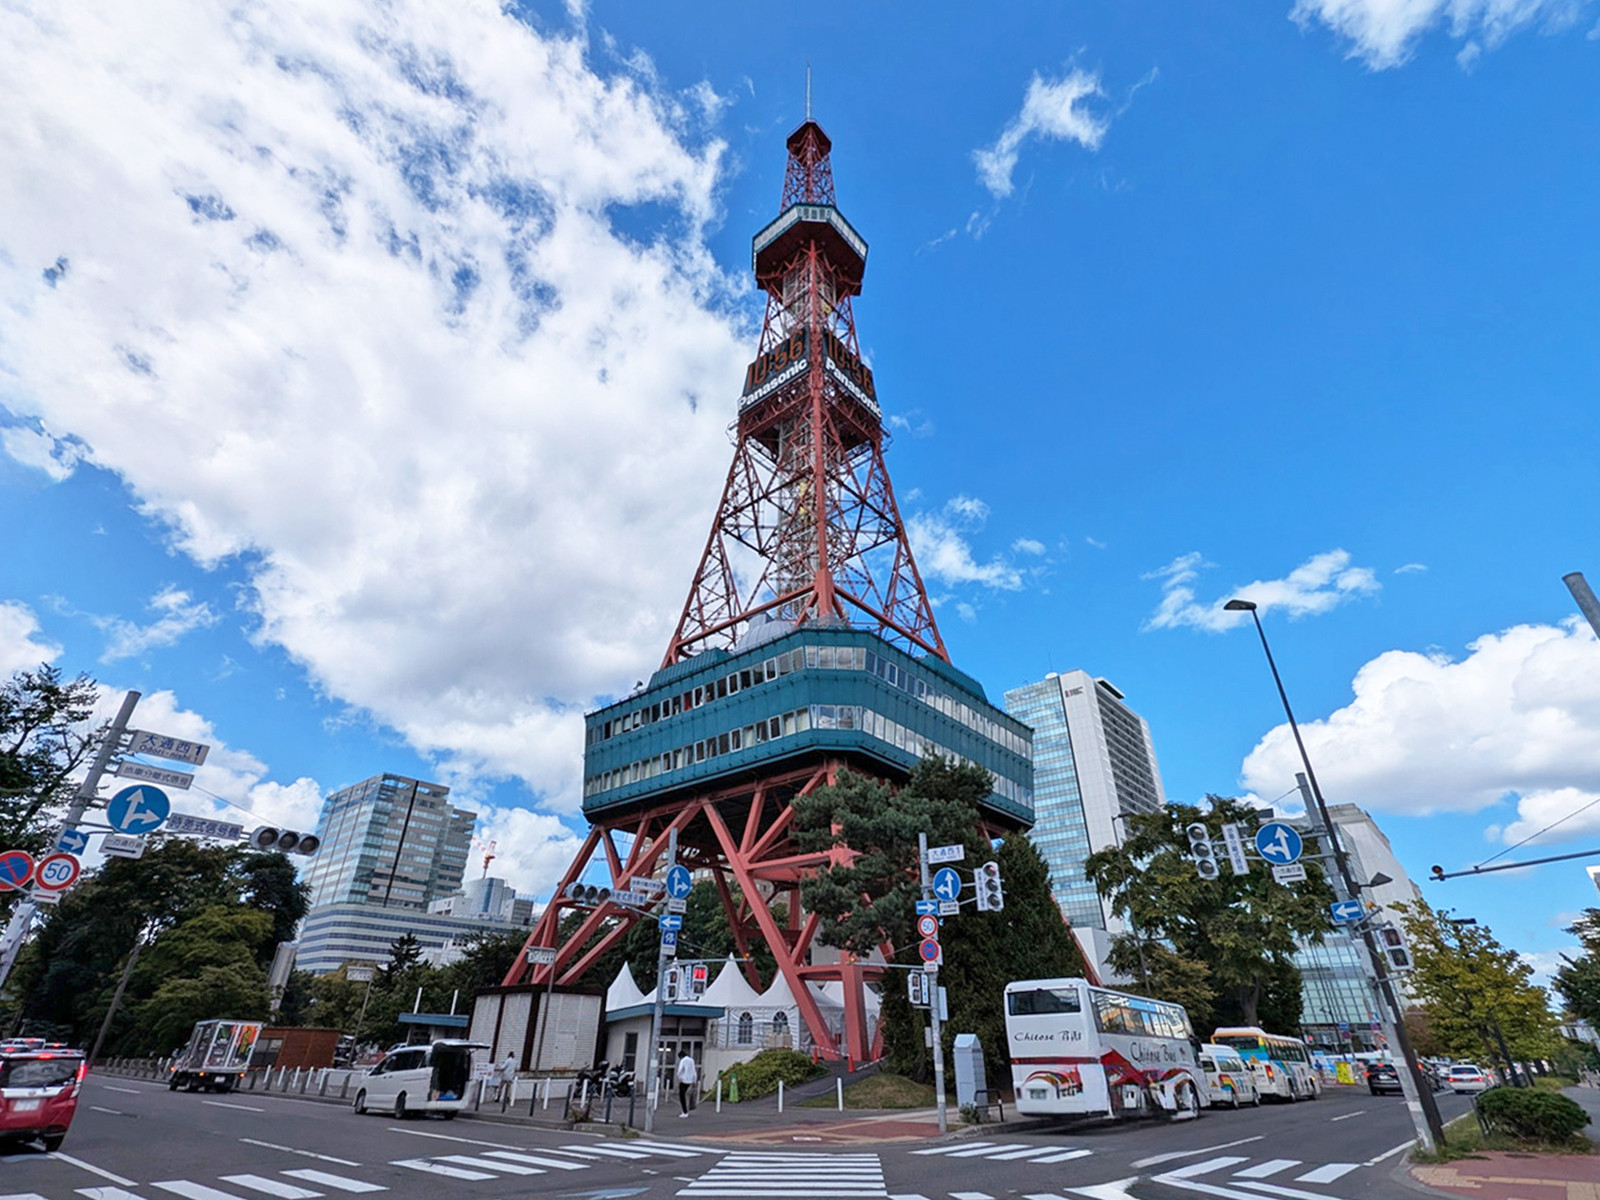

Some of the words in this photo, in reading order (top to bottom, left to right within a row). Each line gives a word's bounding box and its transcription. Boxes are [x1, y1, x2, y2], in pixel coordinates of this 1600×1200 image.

[738, 358, 808, 408] Panasonic
[825, 356, 883, 418] Panasonic
[44, 862, 71, 881] 50
[922, 920, 934, 932] 50
